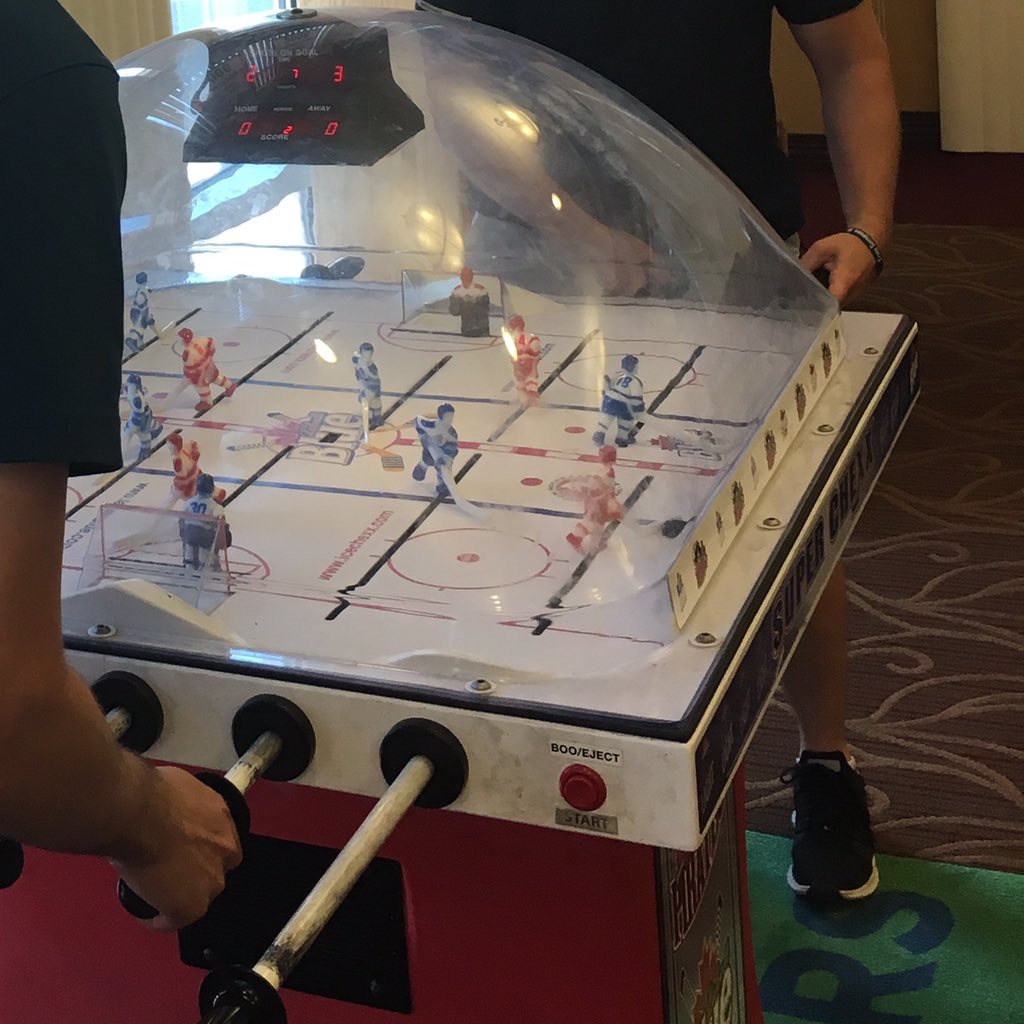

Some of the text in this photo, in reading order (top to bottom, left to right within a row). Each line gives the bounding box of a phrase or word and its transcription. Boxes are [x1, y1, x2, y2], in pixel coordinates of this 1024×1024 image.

[333, 65, 344, 83] 3
[238, 121, 339, 136] 0 2 0
[260, 133, 289, 141] SCORE
[551, 743, 620, 763] BOO/EJECT
